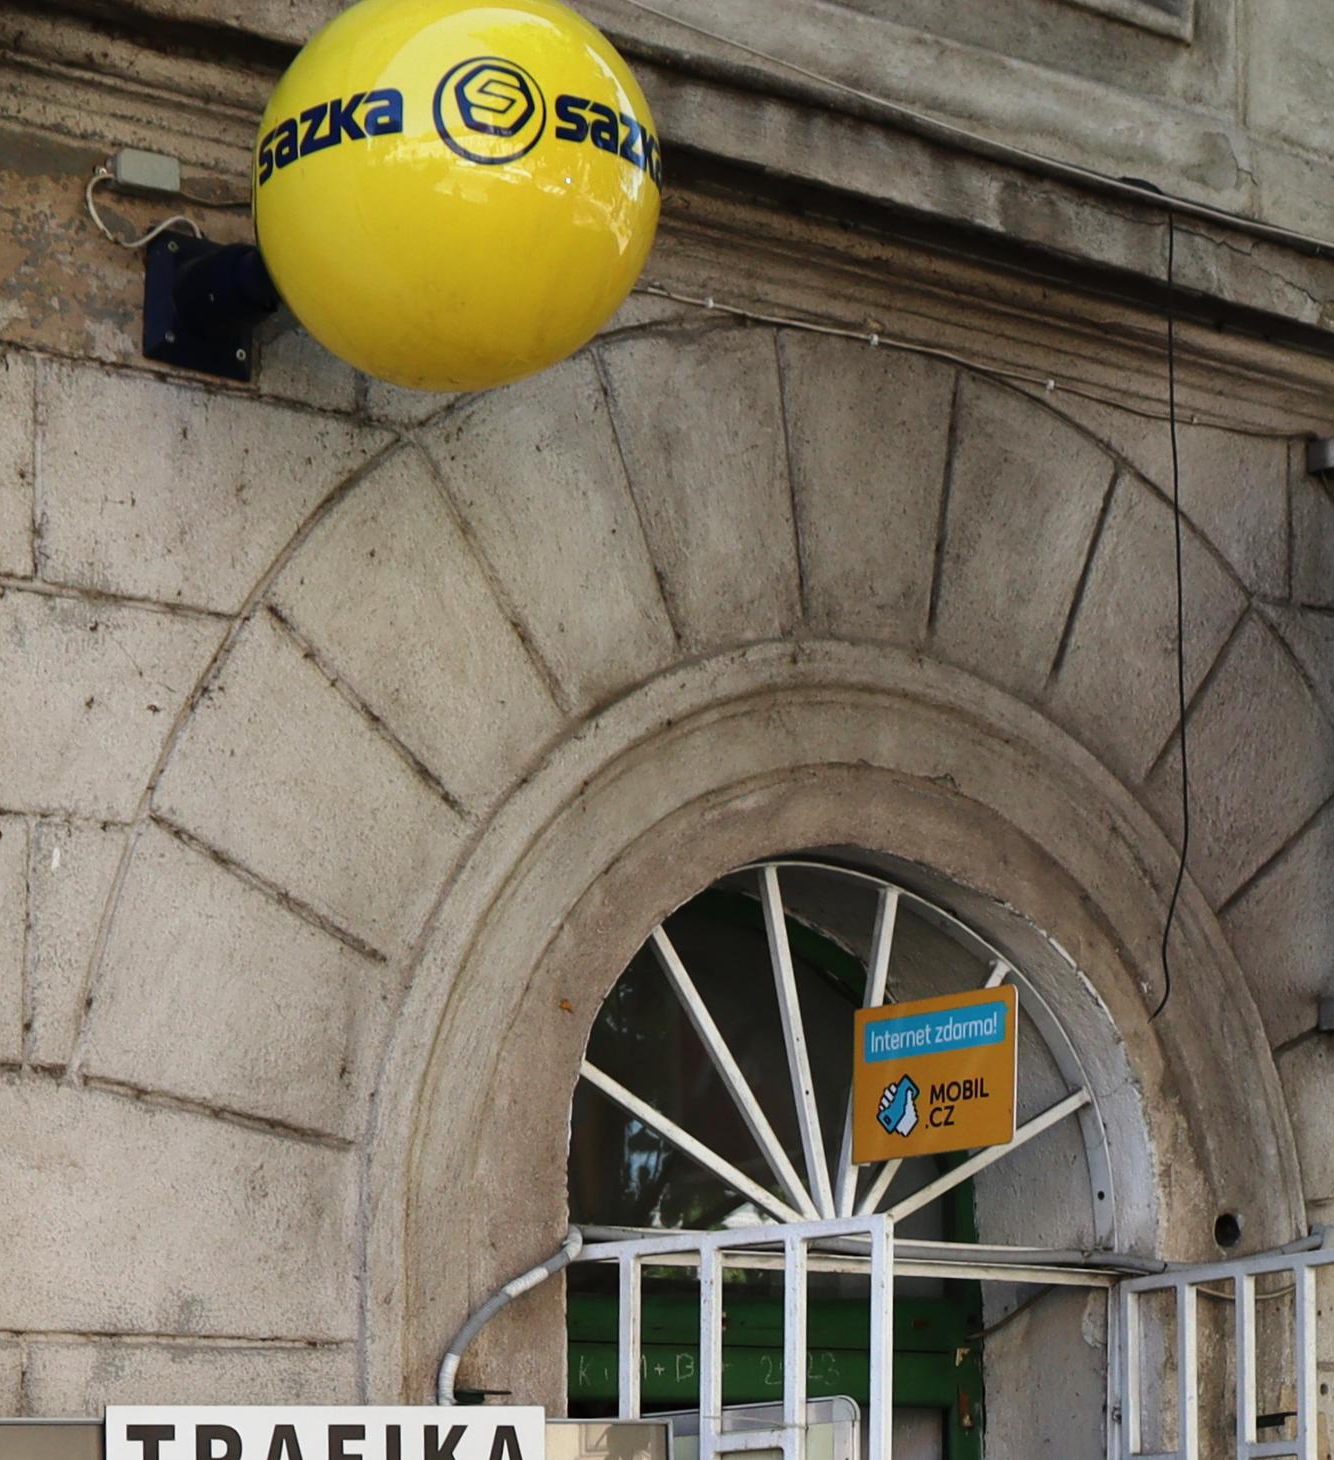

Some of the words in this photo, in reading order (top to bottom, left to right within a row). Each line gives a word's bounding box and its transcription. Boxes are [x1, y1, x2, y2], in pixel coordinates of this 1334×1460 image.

[871, 1023, 932, 1053] Internet
[935, 1011, 998, 1044] zdarma!
[929, 1077, 989, 1105] MOBIL
[925, 1105, 955, 1129] .CZ
